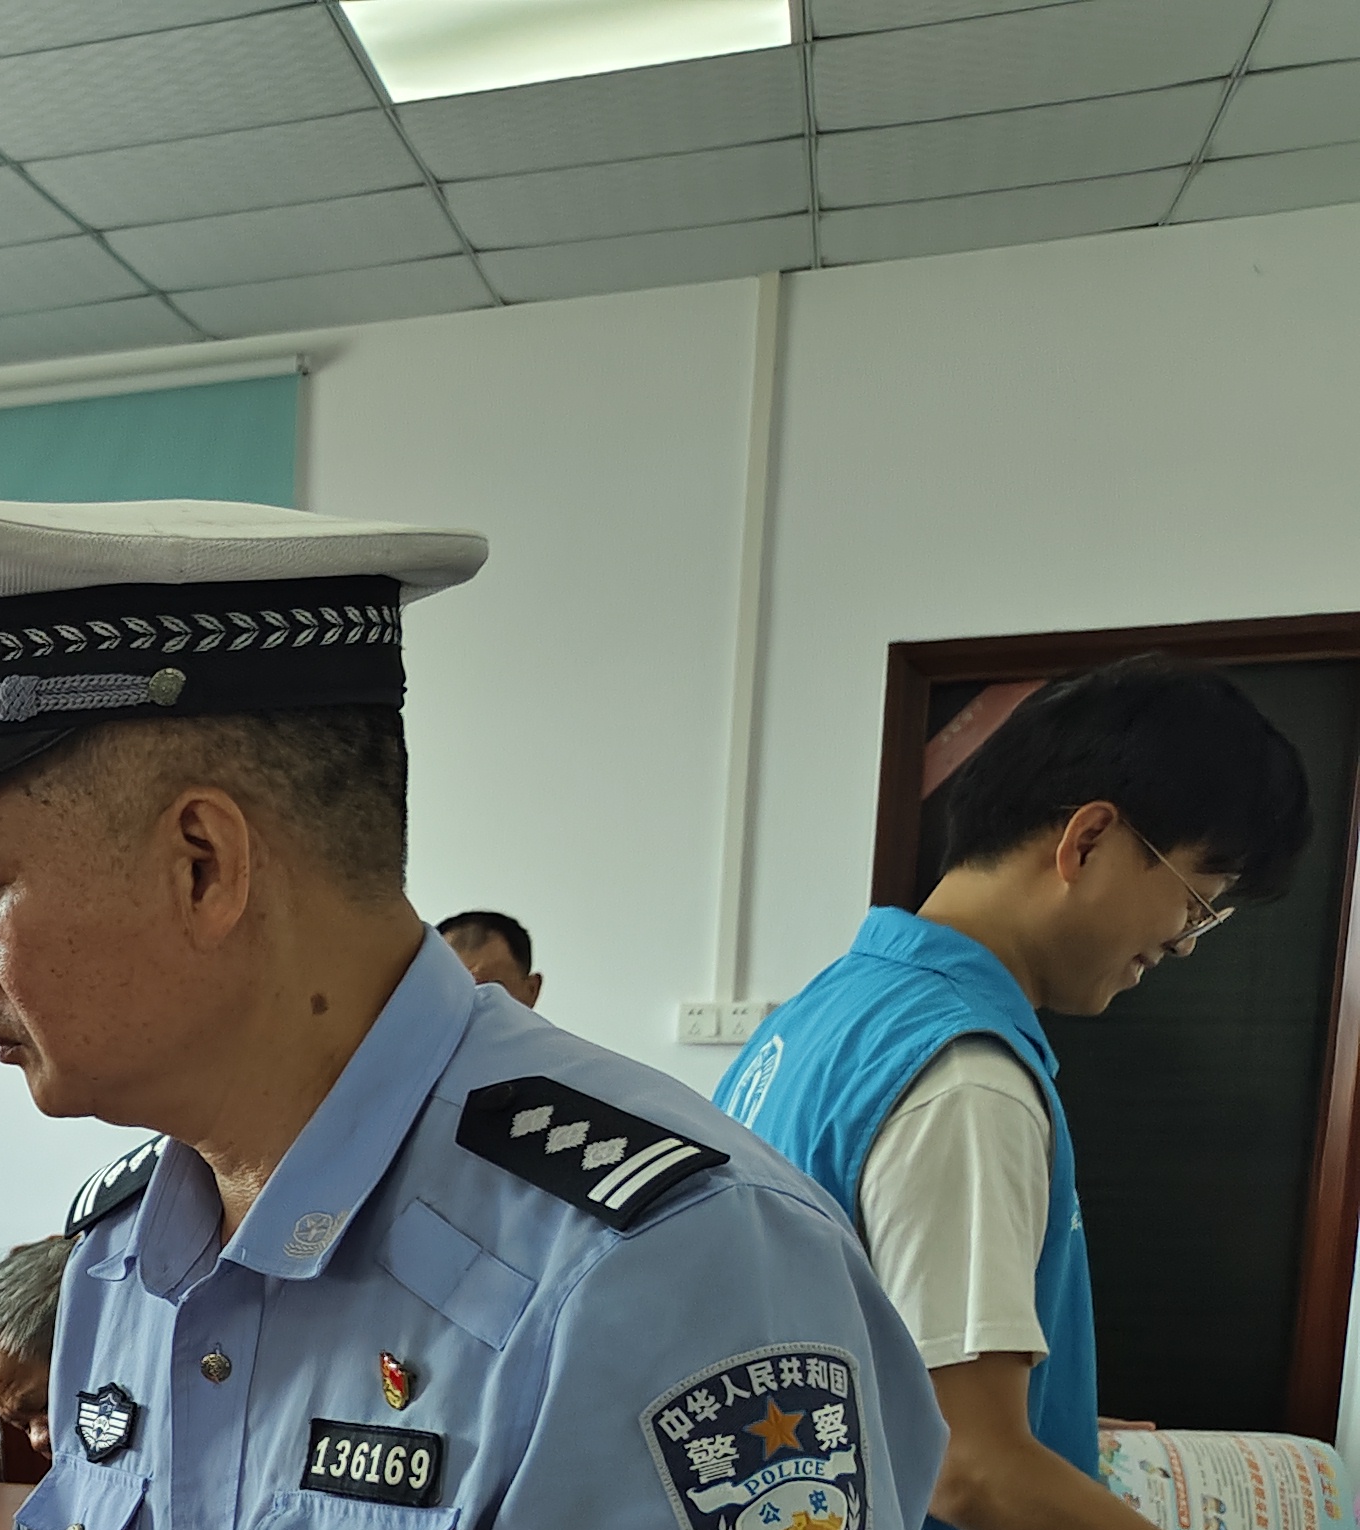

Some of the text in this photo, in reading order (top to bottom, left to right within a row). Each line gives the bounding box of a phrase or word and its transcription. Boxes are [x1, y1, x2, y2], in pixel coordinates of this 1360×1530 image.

[659, 1357, 848, 1442] 中华人民共和国
[310, 1436, 430, 1490] 136169
[744, 1461, 826, 1496] POLICE
